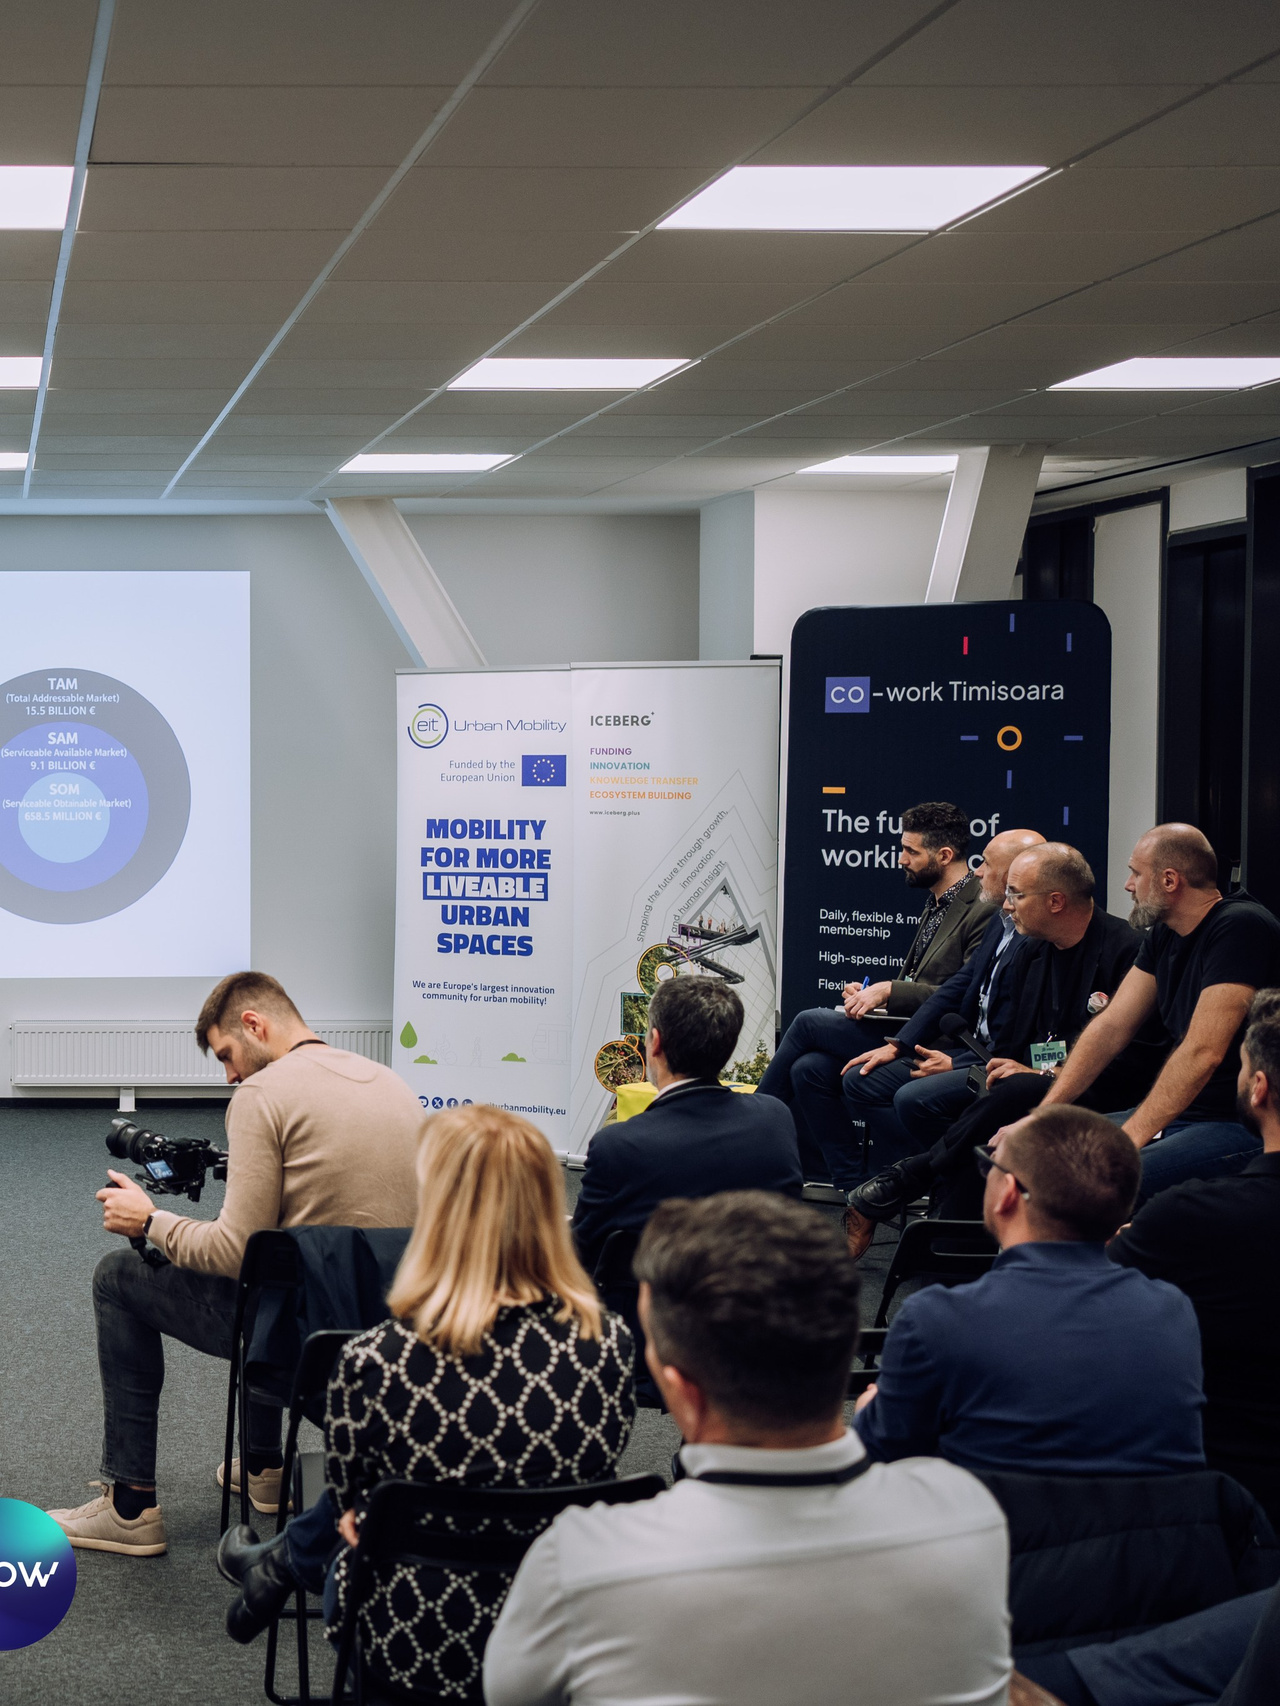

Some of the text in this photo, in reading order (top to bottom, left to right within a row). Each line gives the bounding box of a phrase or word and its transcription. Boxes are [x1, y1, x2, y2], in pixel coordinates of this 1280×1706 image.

[47, 677, 78, 690] TAM
[6, 693, 120, 703] (Total Addressable Market)
[949, 680, 1065, 702] Timisoara
[25, 706, 46, 715] 15.5
[48, 706, 87, 715] BILLION
[417, 718, 567, 733] eit Urban Mobility
[47, 732, 78, 745] SAM
[1, 748, 127, 758] (Serviceable Available Market)
[30, 761, 45, 770] 9.1
[48, 761, 87, 770] BILLION
[449, 760, 515, 771] Funded by the
[590, 762, 650, 770] INNOVATION
[440, 773, 515, 783] European Union
[590, 777, 699, 785] KNOWLEDGE TRANSFER
[49, 783, 80, 795] SOM
[590, 791, 692, 800] ECOSYSTEM BUILDING
[2, 799, 52, 809] (Serviceable
[99, 799, 132, 808] Market)
[24, 811, 50, 821] 658.5
[52, 811, 92, 821] MILLION
[822, 809, 870, 833] The
[969, 813, 1000, 836] of
[426, 818, 546, 840] MOBILITY
[420, 847, 551, 870] FOR MORE
[821, 845, 903, 869] worki
[679, 848, 716, 889] innovation
[637, 809, 728, 943] Shaping the future through growth,
[426, 875, 545, 900] LIVEABLE
[671, 860, 727, 933] and human insight.
[441, 904, 529, 927] URBAN
[819, 908, 850, 923] Daily,
[852, 910, 893, 924] flexible
[895, 913, 904, 924] &
[819, 925, 891, 940] membership
[437, 933, 533, 956] SPACES
[818, 951, 887, 966] High-speed
[412, 980, 426, 988] We
[443, 981, 478, 992] Europe's
[479, 983, 509, 993] largest
[510, 985, 555, 994] innovation
[422, 992, 547, 1006] community for urban mobility!
[1034, 1051, 1065, 1062] DEMO
